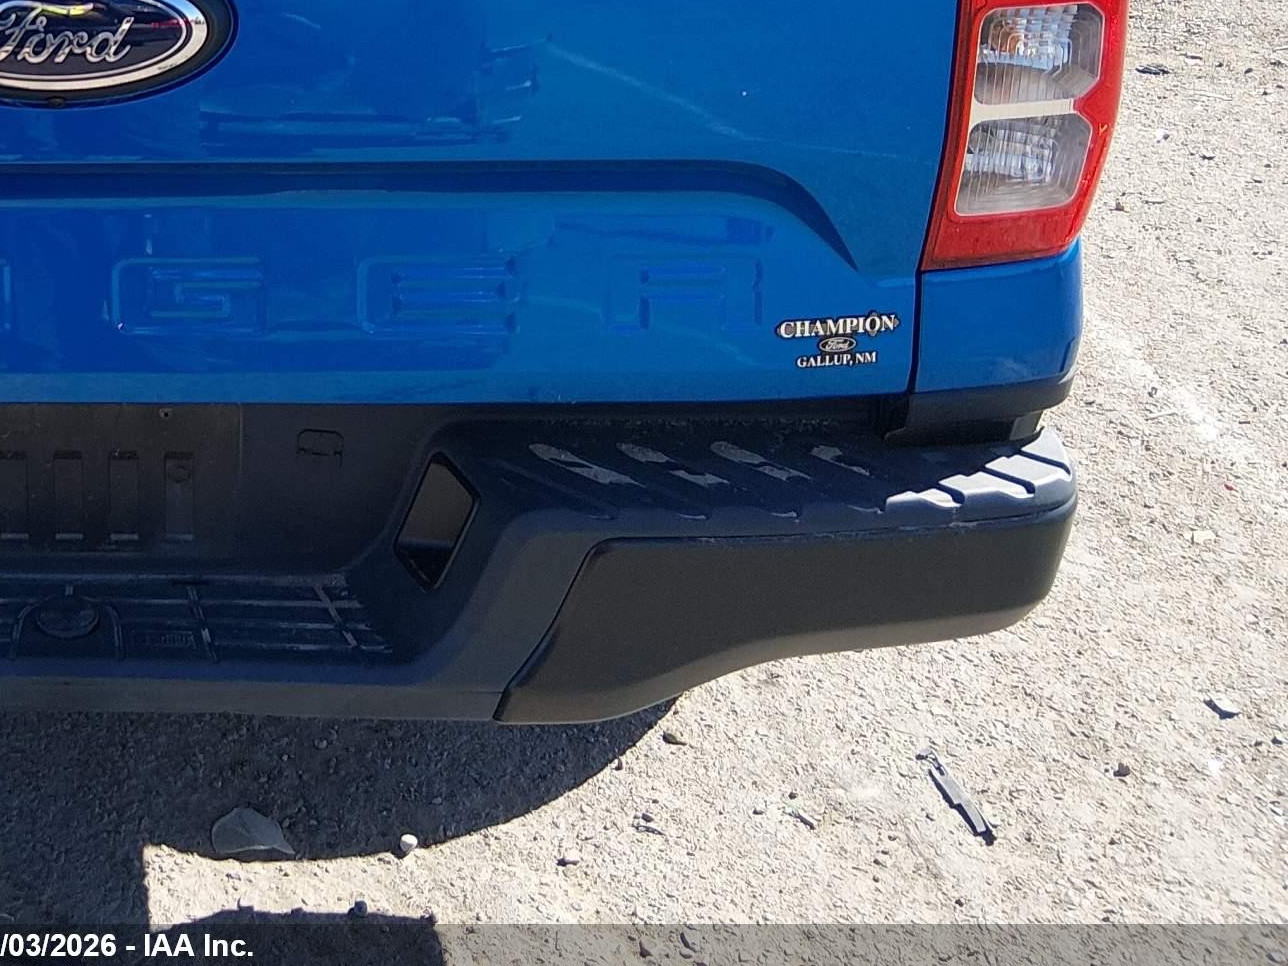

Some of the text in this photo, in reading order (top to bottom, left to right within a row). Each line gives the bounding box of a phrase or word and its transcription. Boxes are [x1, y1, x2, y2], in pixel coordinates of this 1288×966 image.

[779, 314, 896, 339] CHAMPION
[824, 338, 851, 351] Ford
[797, 351, 877, 368] GALLUP, NM
